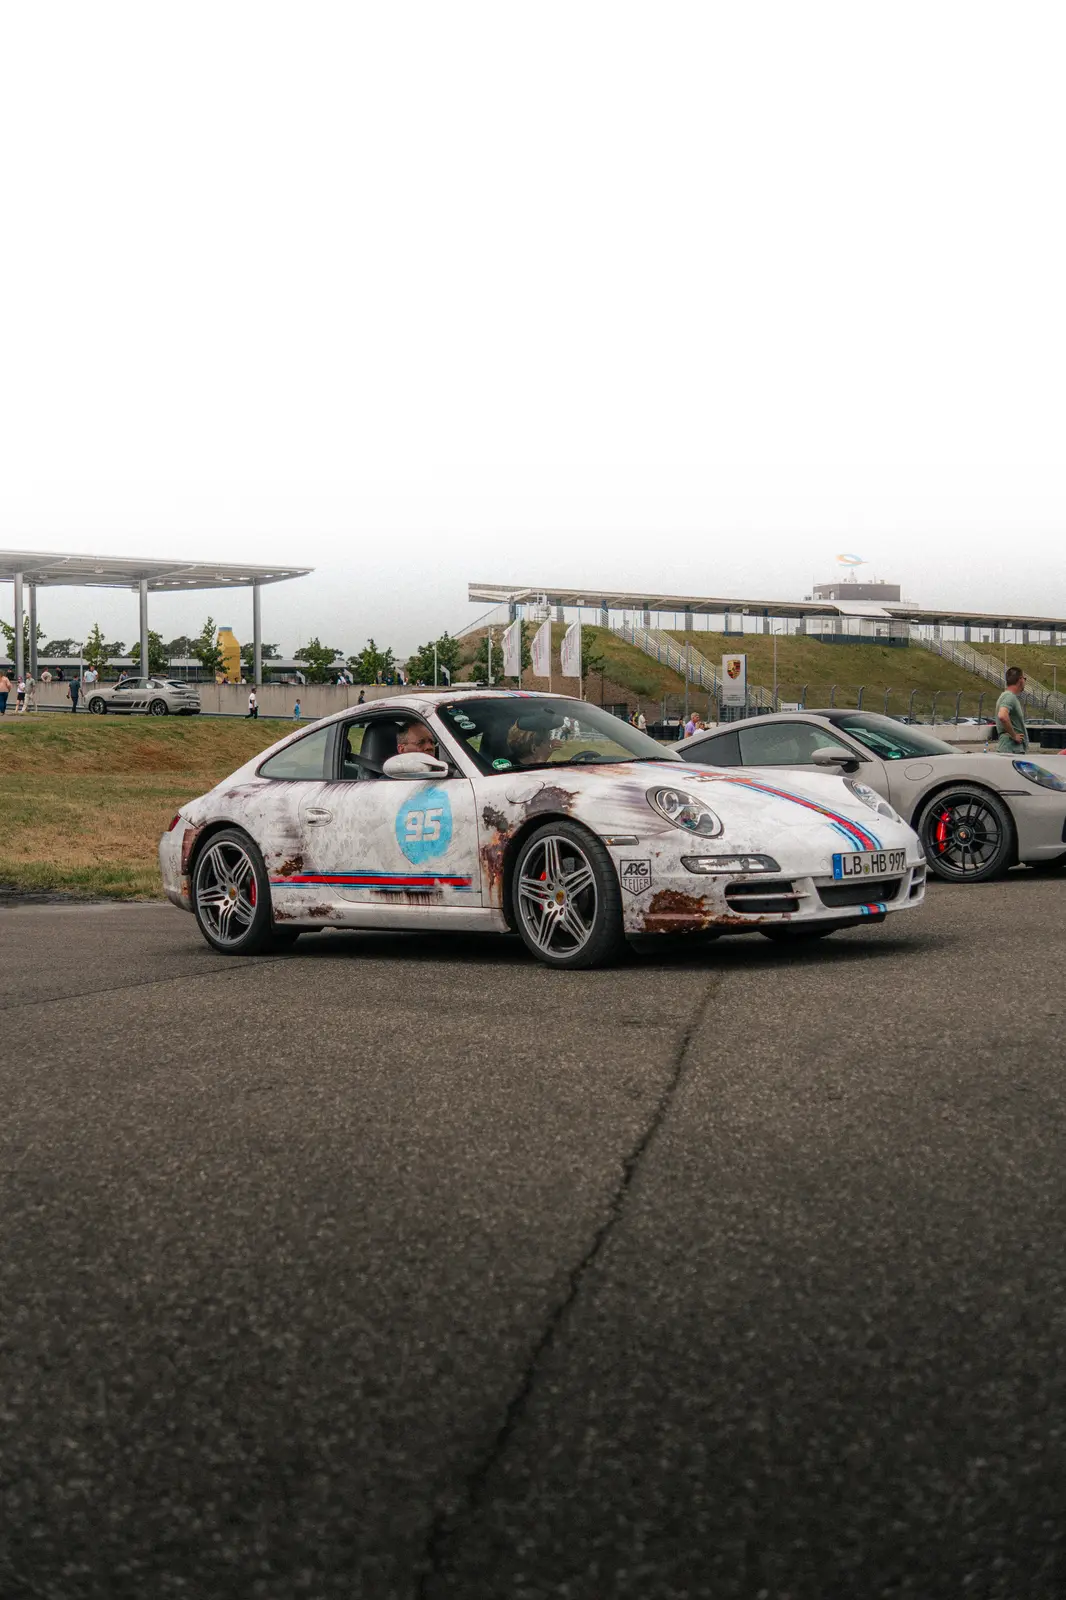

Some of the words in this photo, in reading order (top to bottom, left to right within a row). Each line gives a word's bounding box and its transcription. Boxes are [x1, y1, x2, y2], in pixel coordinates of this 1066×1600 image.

[405, 807, 443, 841] 95
[624, 862, 648, 875] ARG
[842, 855, 862, 875] LB
[870, 853, 886, 873] HB
[889, 851, 906, 871] 997
[623, 879, 649, 892] TEUER
